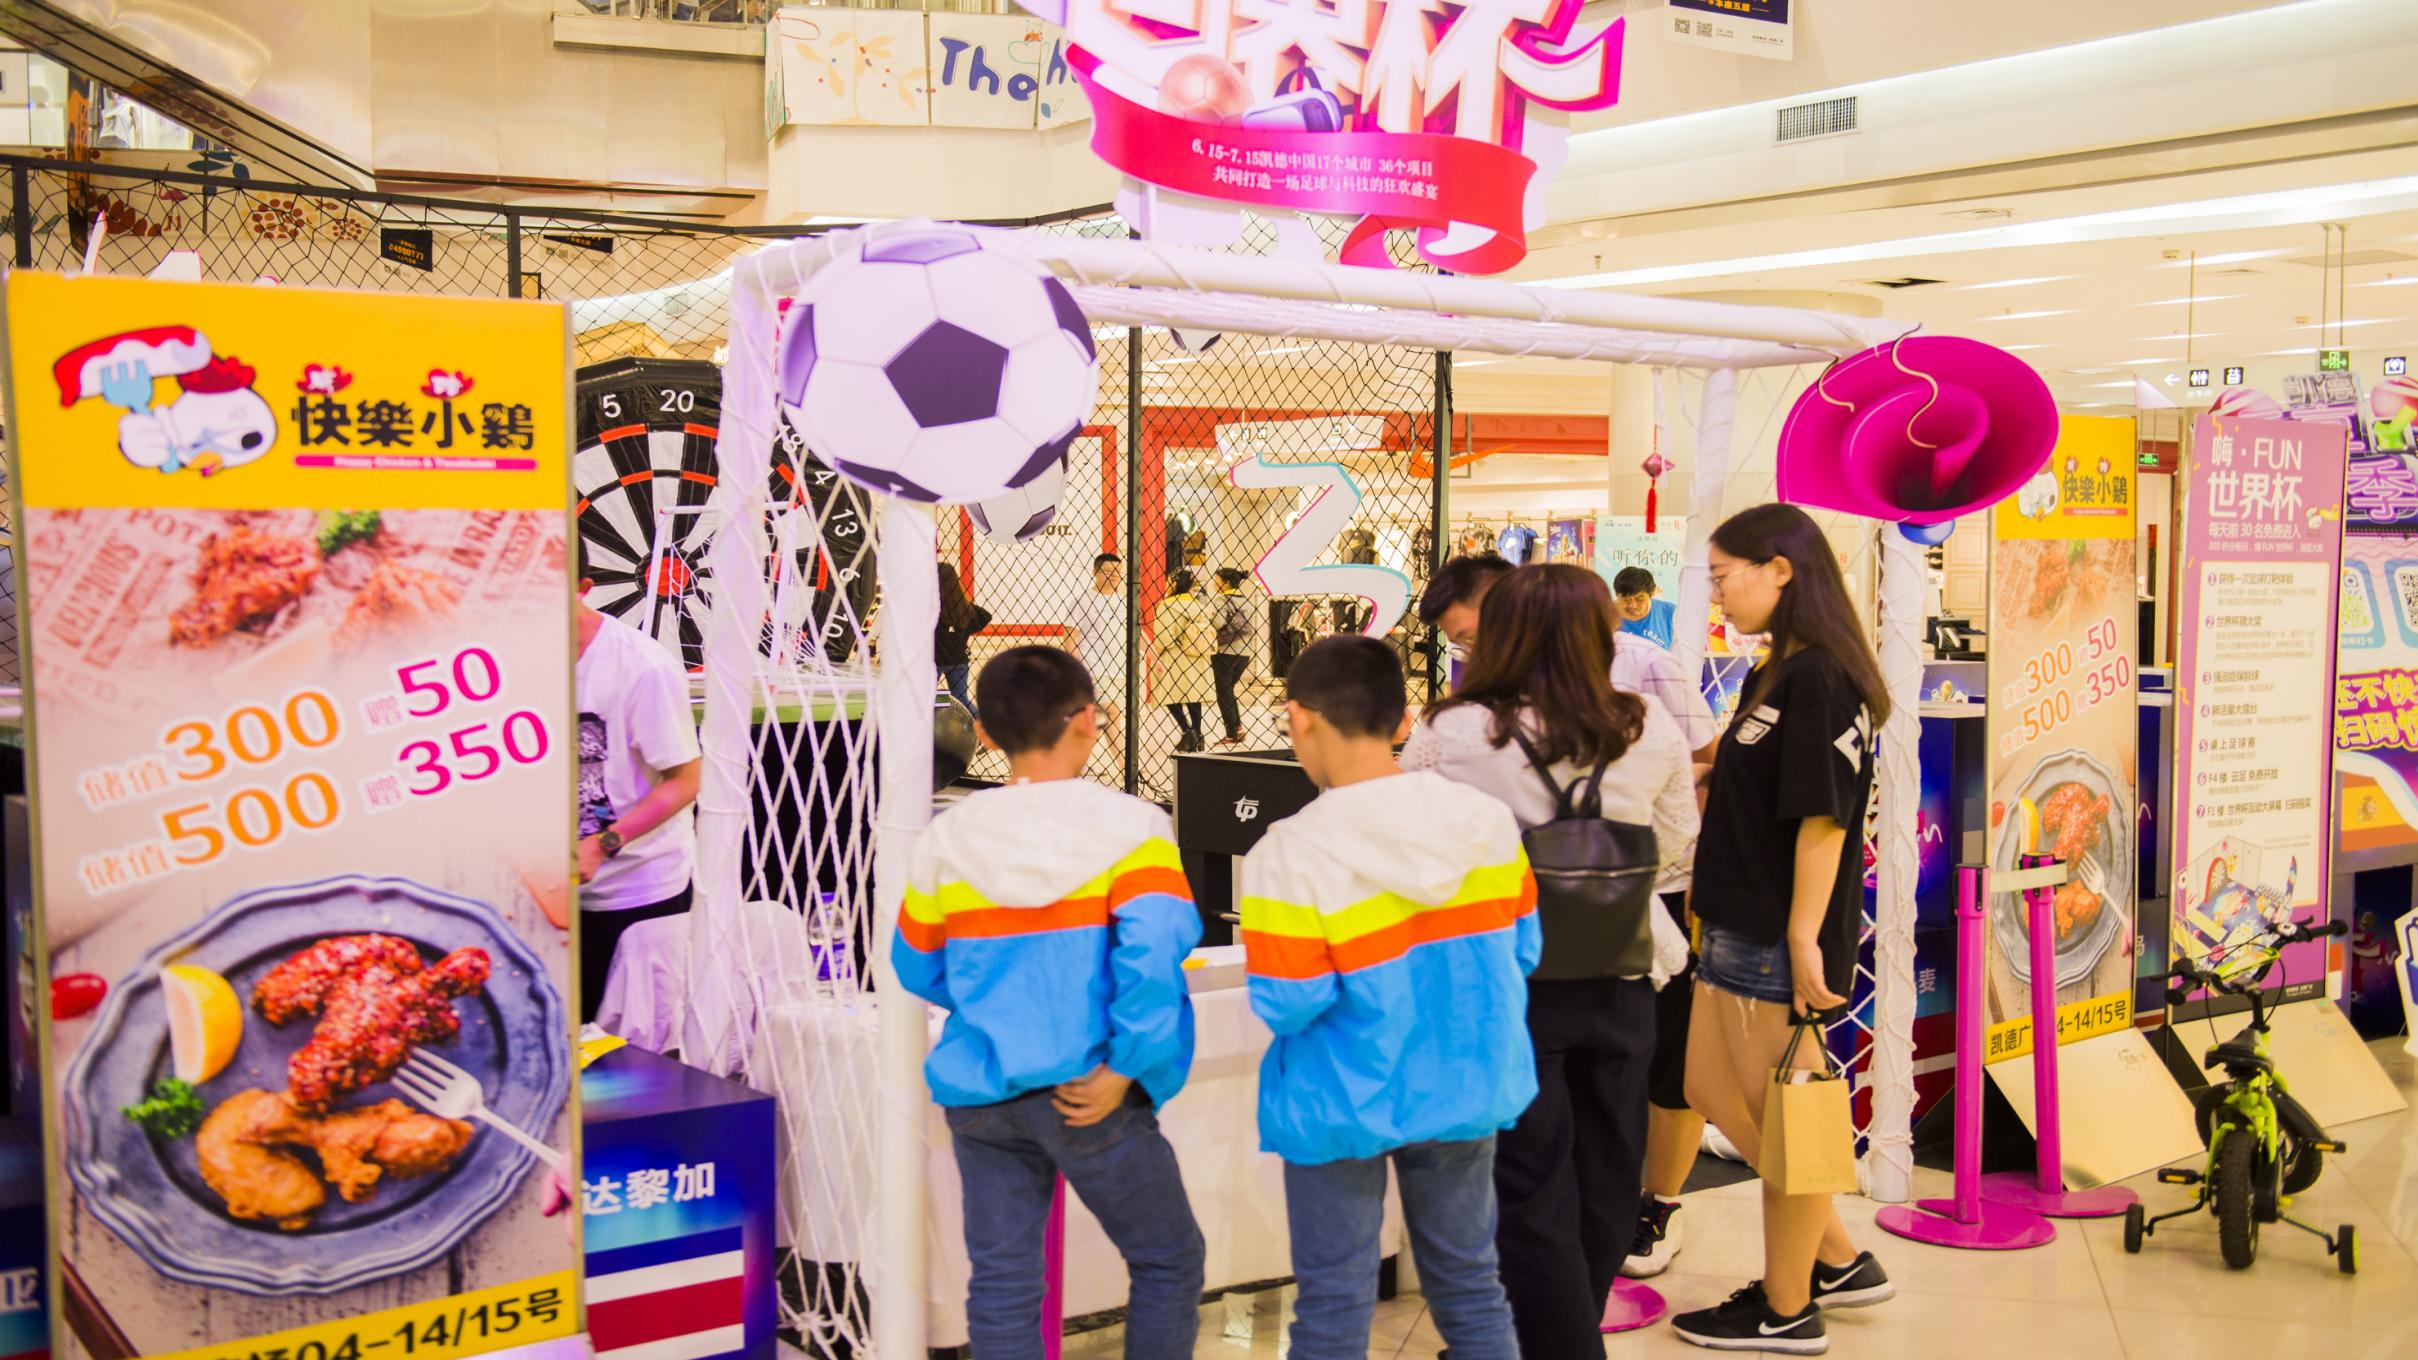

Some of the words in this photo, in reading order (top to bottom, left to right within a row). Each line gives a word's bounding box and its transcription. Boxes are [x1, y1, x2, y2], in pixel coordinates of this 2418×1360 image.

[602, 393, 622, 419] 5
[659, 388, 695, 413] 20
[2207, 470, 2304, 522] 世界杯
[830, 507, 859, 538] 13
[1611, 545, 1679, 568] 听你的
[823, 611, 850, 640] 10
[1990, 999, 2127, 1056] 凯德广4-14/15号
